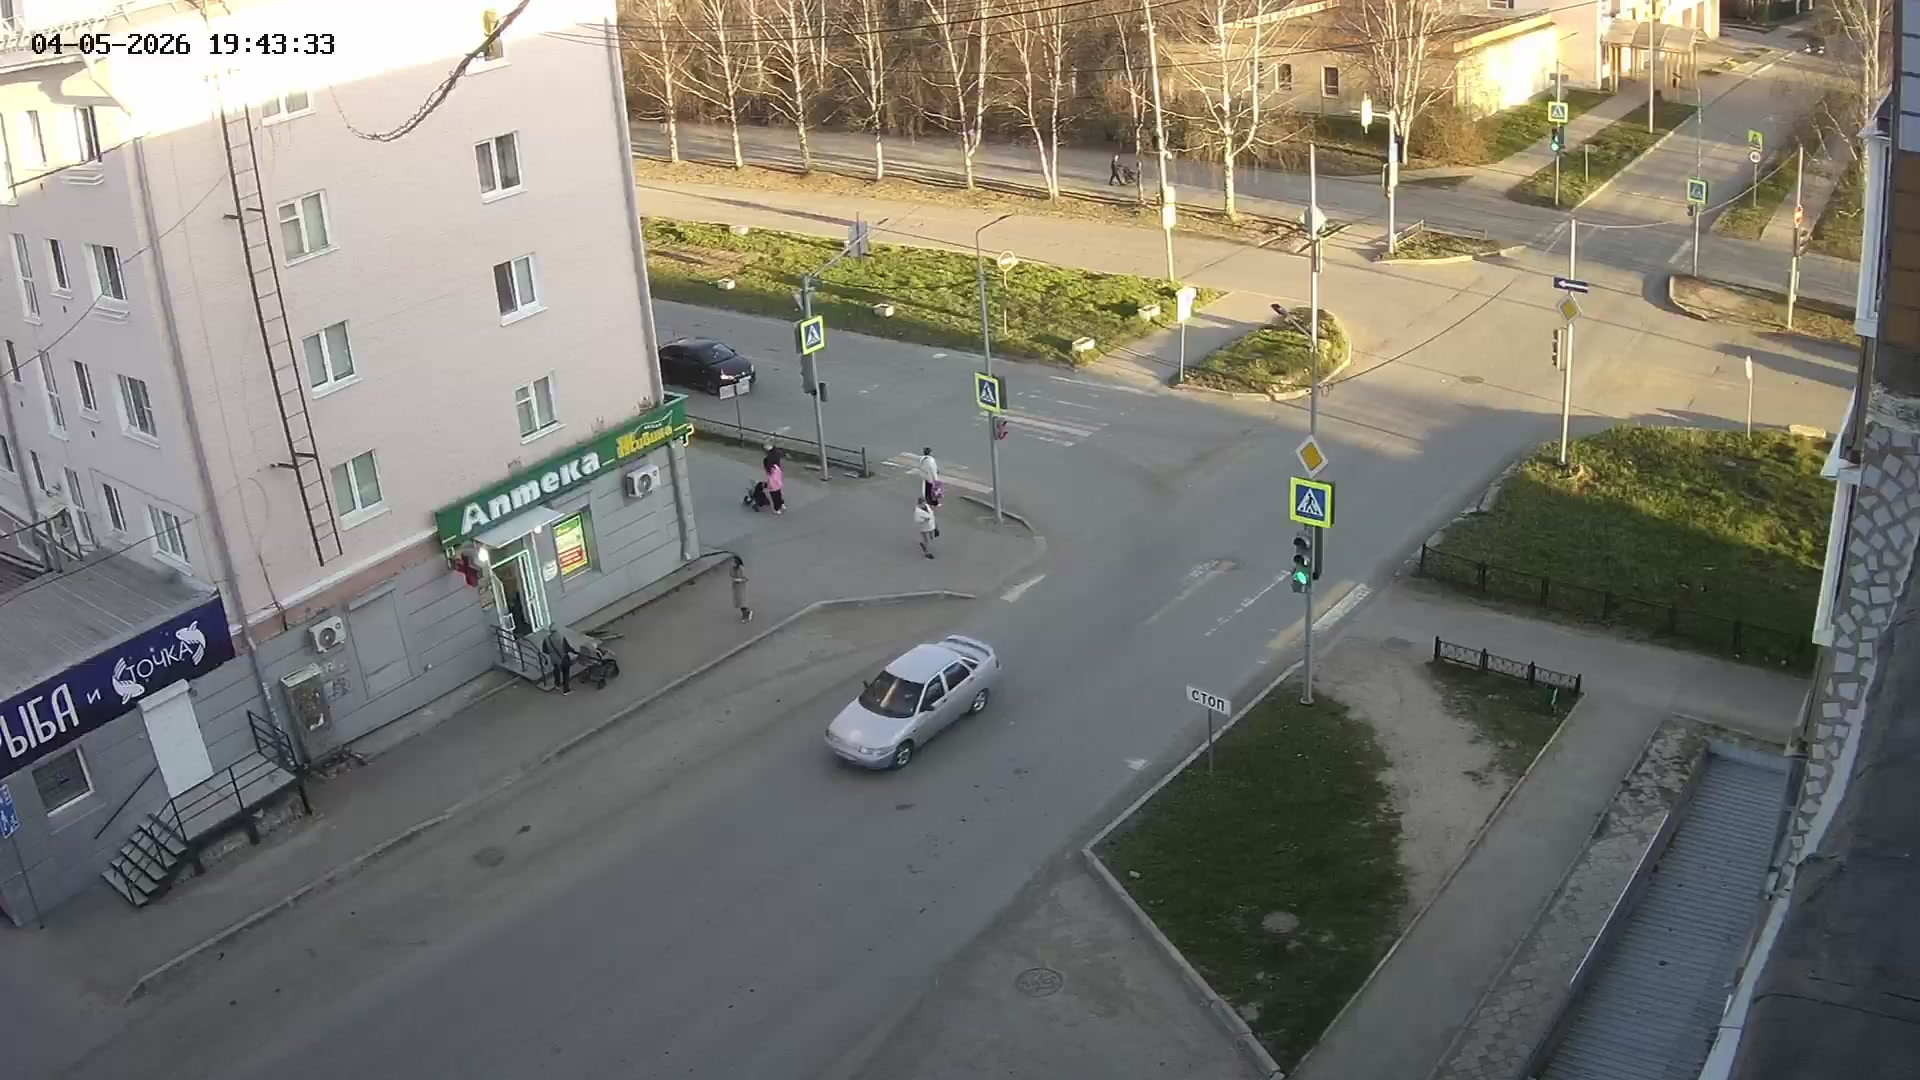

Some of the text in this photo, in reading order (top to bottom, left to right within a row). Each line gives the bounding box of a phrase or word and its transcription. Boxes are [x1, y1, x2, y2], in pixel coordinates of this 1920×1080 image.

[460, 451, 601, 536] Аптека
[0, 640, 194, 758] ЫБА и ТОЧКА
[1191, 690, 1225, 712] СТОП
